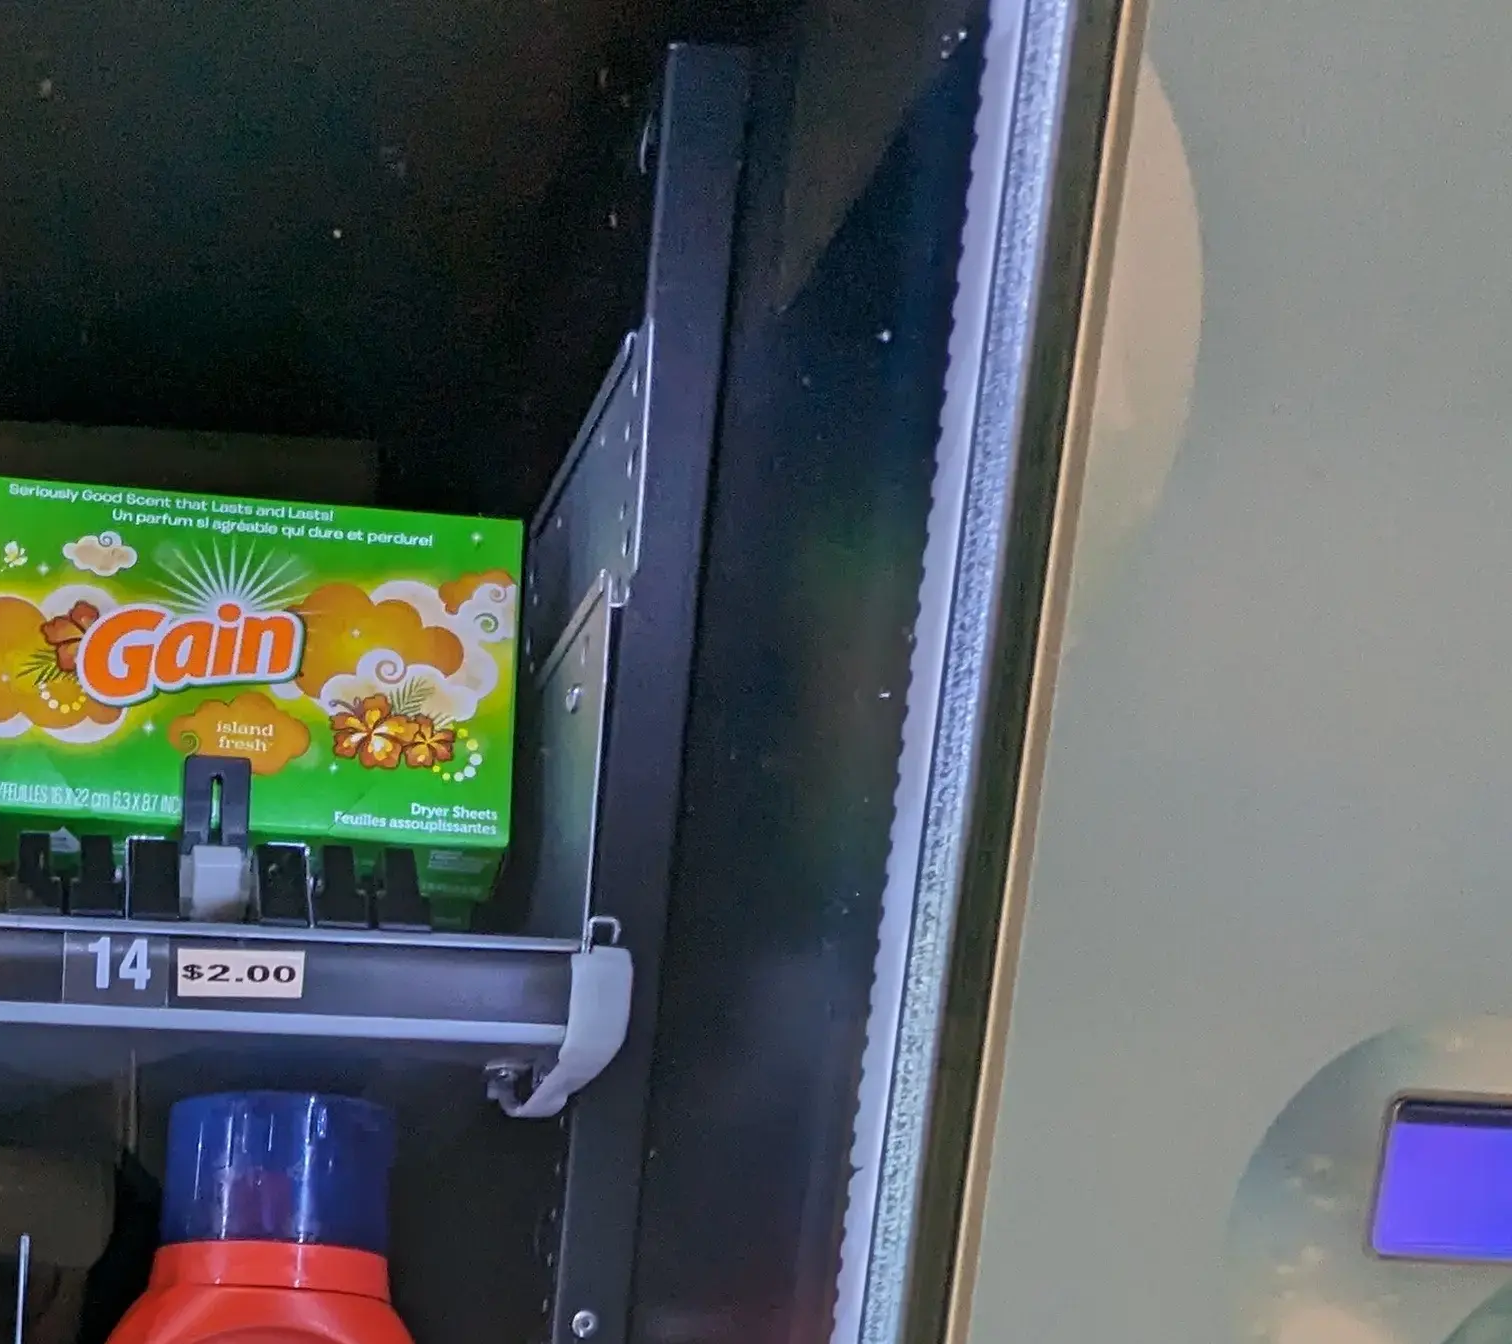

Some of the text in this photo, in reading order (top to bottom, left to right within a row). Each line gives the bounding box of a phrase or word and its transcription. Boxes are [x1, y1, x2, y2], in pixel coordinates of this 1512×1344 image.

[9, 483, 333, 522] Seriously Good Scent that Lasts and Lasts!
[112, 508, 133, 522] Un
[136, 512, 192, 527] parfum
[282, 526, 305, 539] qui
[309, 528, 344, 539] dure
[347, 532, 363, 541] et
[368, 532, 433, 547] perdure!
[79, 601, 303, 704] Gain
[215, 719, 274, 740] island
[218, 736, 270, 753] fresh
[334, 811, 497, 835] Feuilles assouplissantes
[411, 802, 497, 820] Dryer Sheets
[88, 936, 151, 990] 14
[182, 964, 296, 983] $2.00
